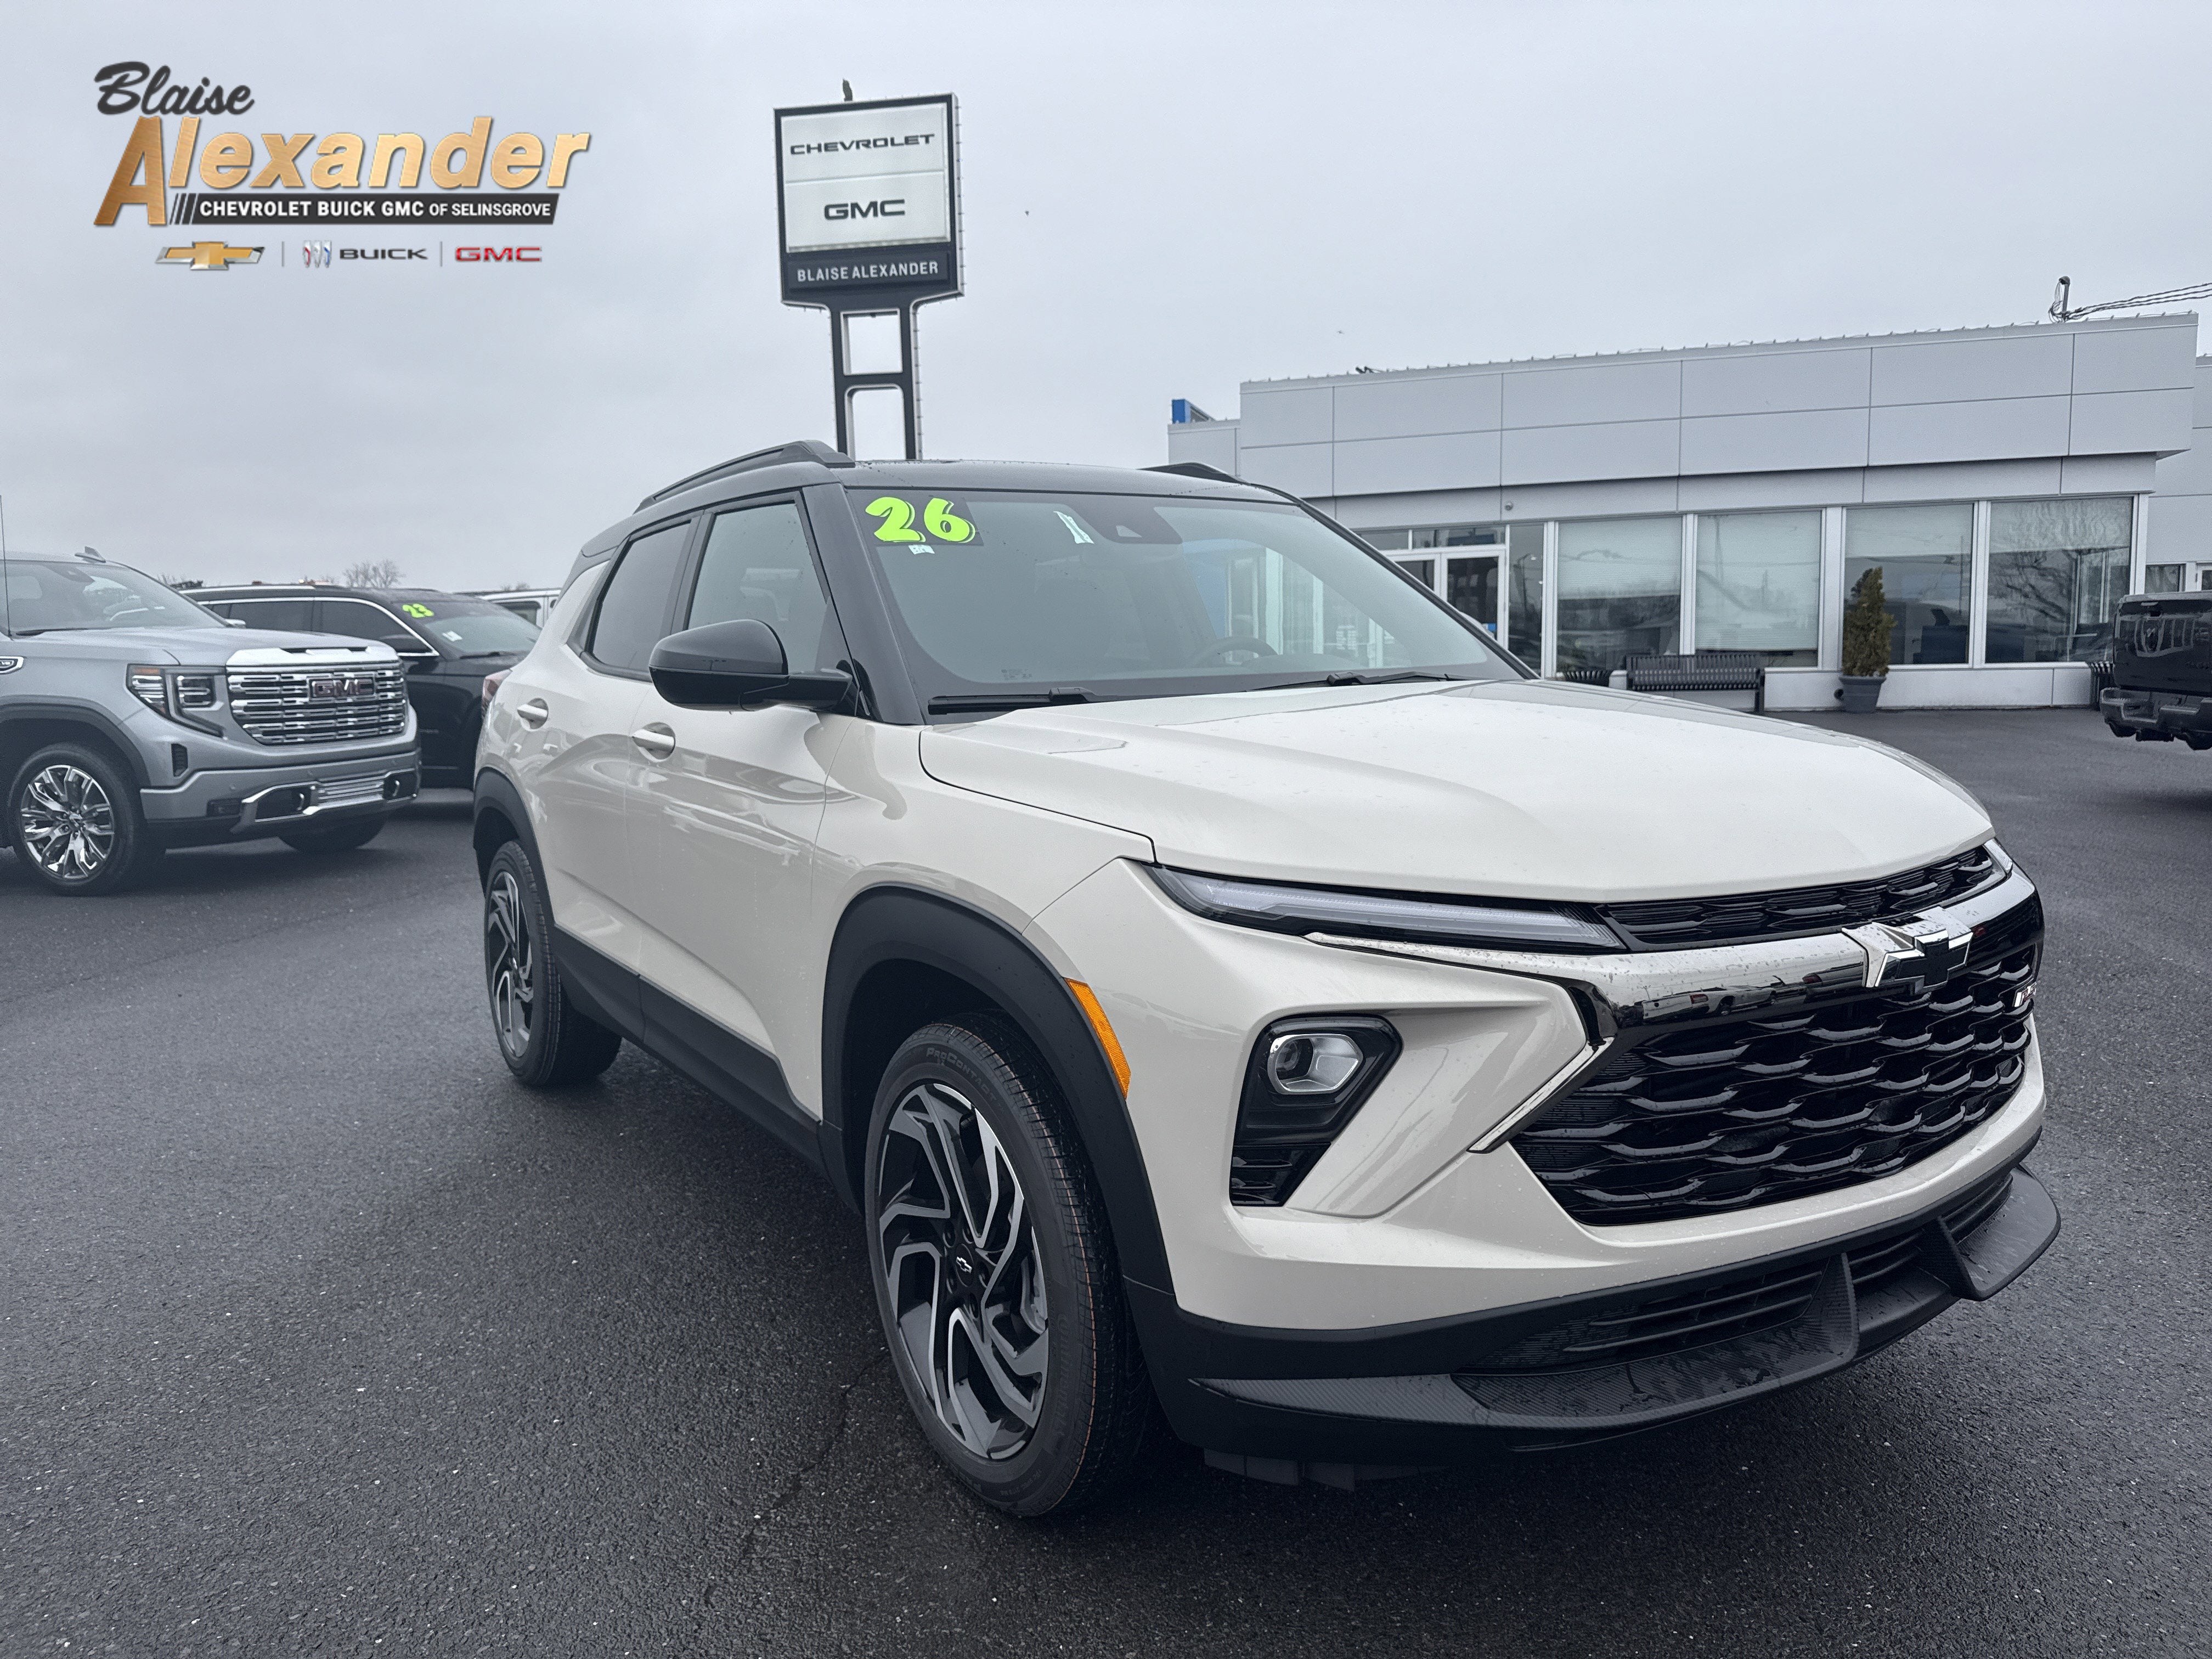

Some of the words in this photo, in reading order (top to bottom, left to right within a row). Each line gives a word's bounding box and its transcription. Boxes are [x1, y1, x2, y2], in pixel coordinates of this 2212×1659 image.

[791, 134, 935, 155] CHEVROLET
[824, 199, 905, 220] GMC
[797, 266, 848, 282] BLAISE
[852, 261, 938, 279] ALEXANDER
[865, 496, 975, 543] 26
[402, 603, 434, 618] 23
[312, 678, 373, 697] GMC
